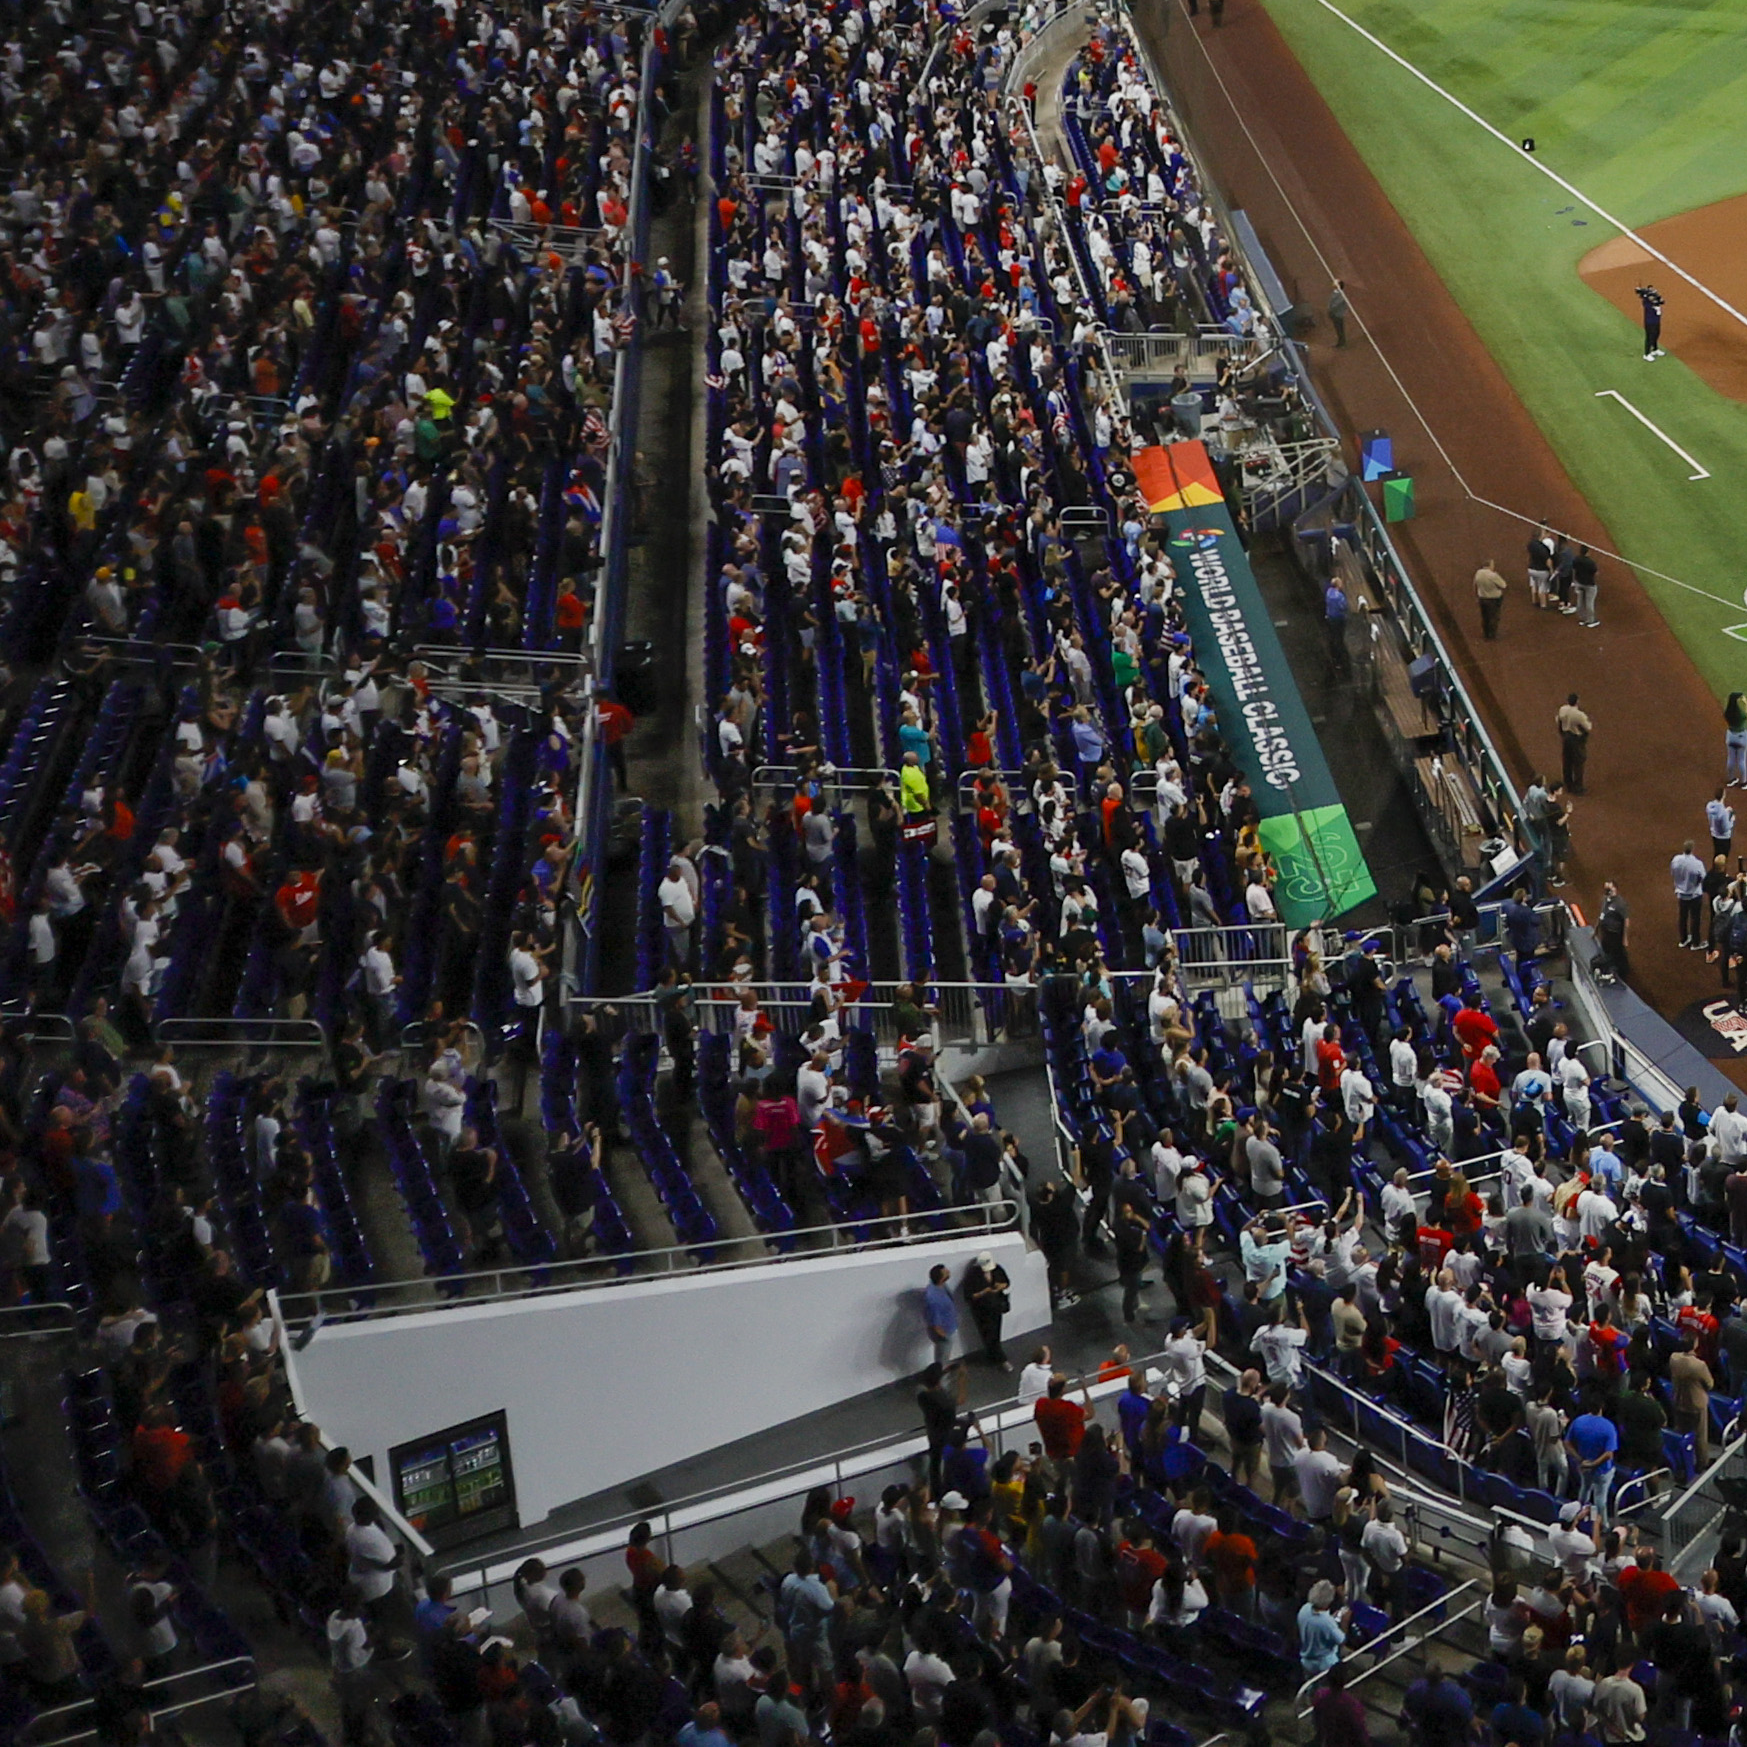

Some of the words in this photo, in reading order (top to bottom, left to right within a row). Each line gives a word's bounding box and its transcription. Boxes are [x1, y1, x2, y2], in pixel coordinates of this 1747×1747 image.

[1189, 548, 1236, 609] WORLD
[1209, 608, 1268, 702] BASEBALL
[1242, 701, 1300, 791] CLASSIC
